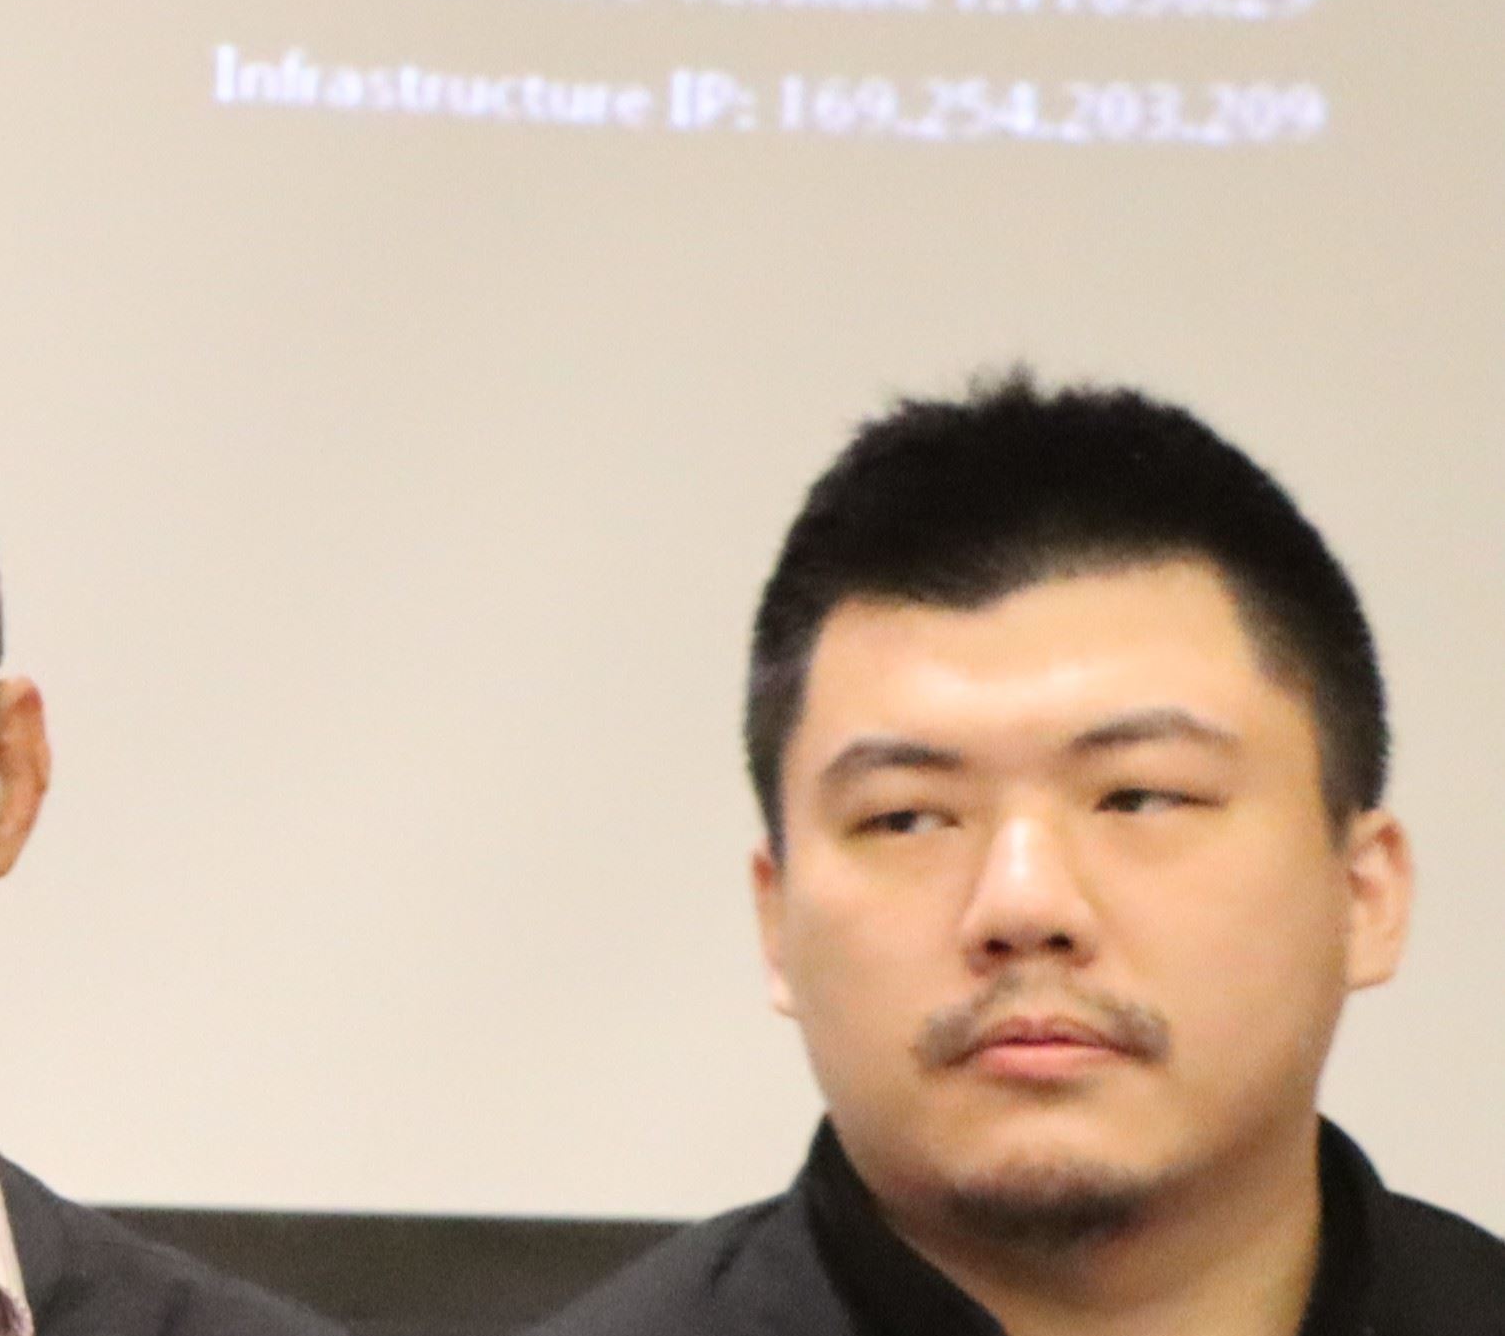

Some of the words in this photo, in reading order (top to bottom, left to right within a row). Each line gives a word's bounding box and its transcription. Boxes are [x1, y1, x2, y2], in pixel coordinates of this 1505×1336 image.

[215, 43, 654, 125] Infrastructure
[669, 69, 756, 131] IP:
[779, 72, 1327, 144] 169.254.203.209
